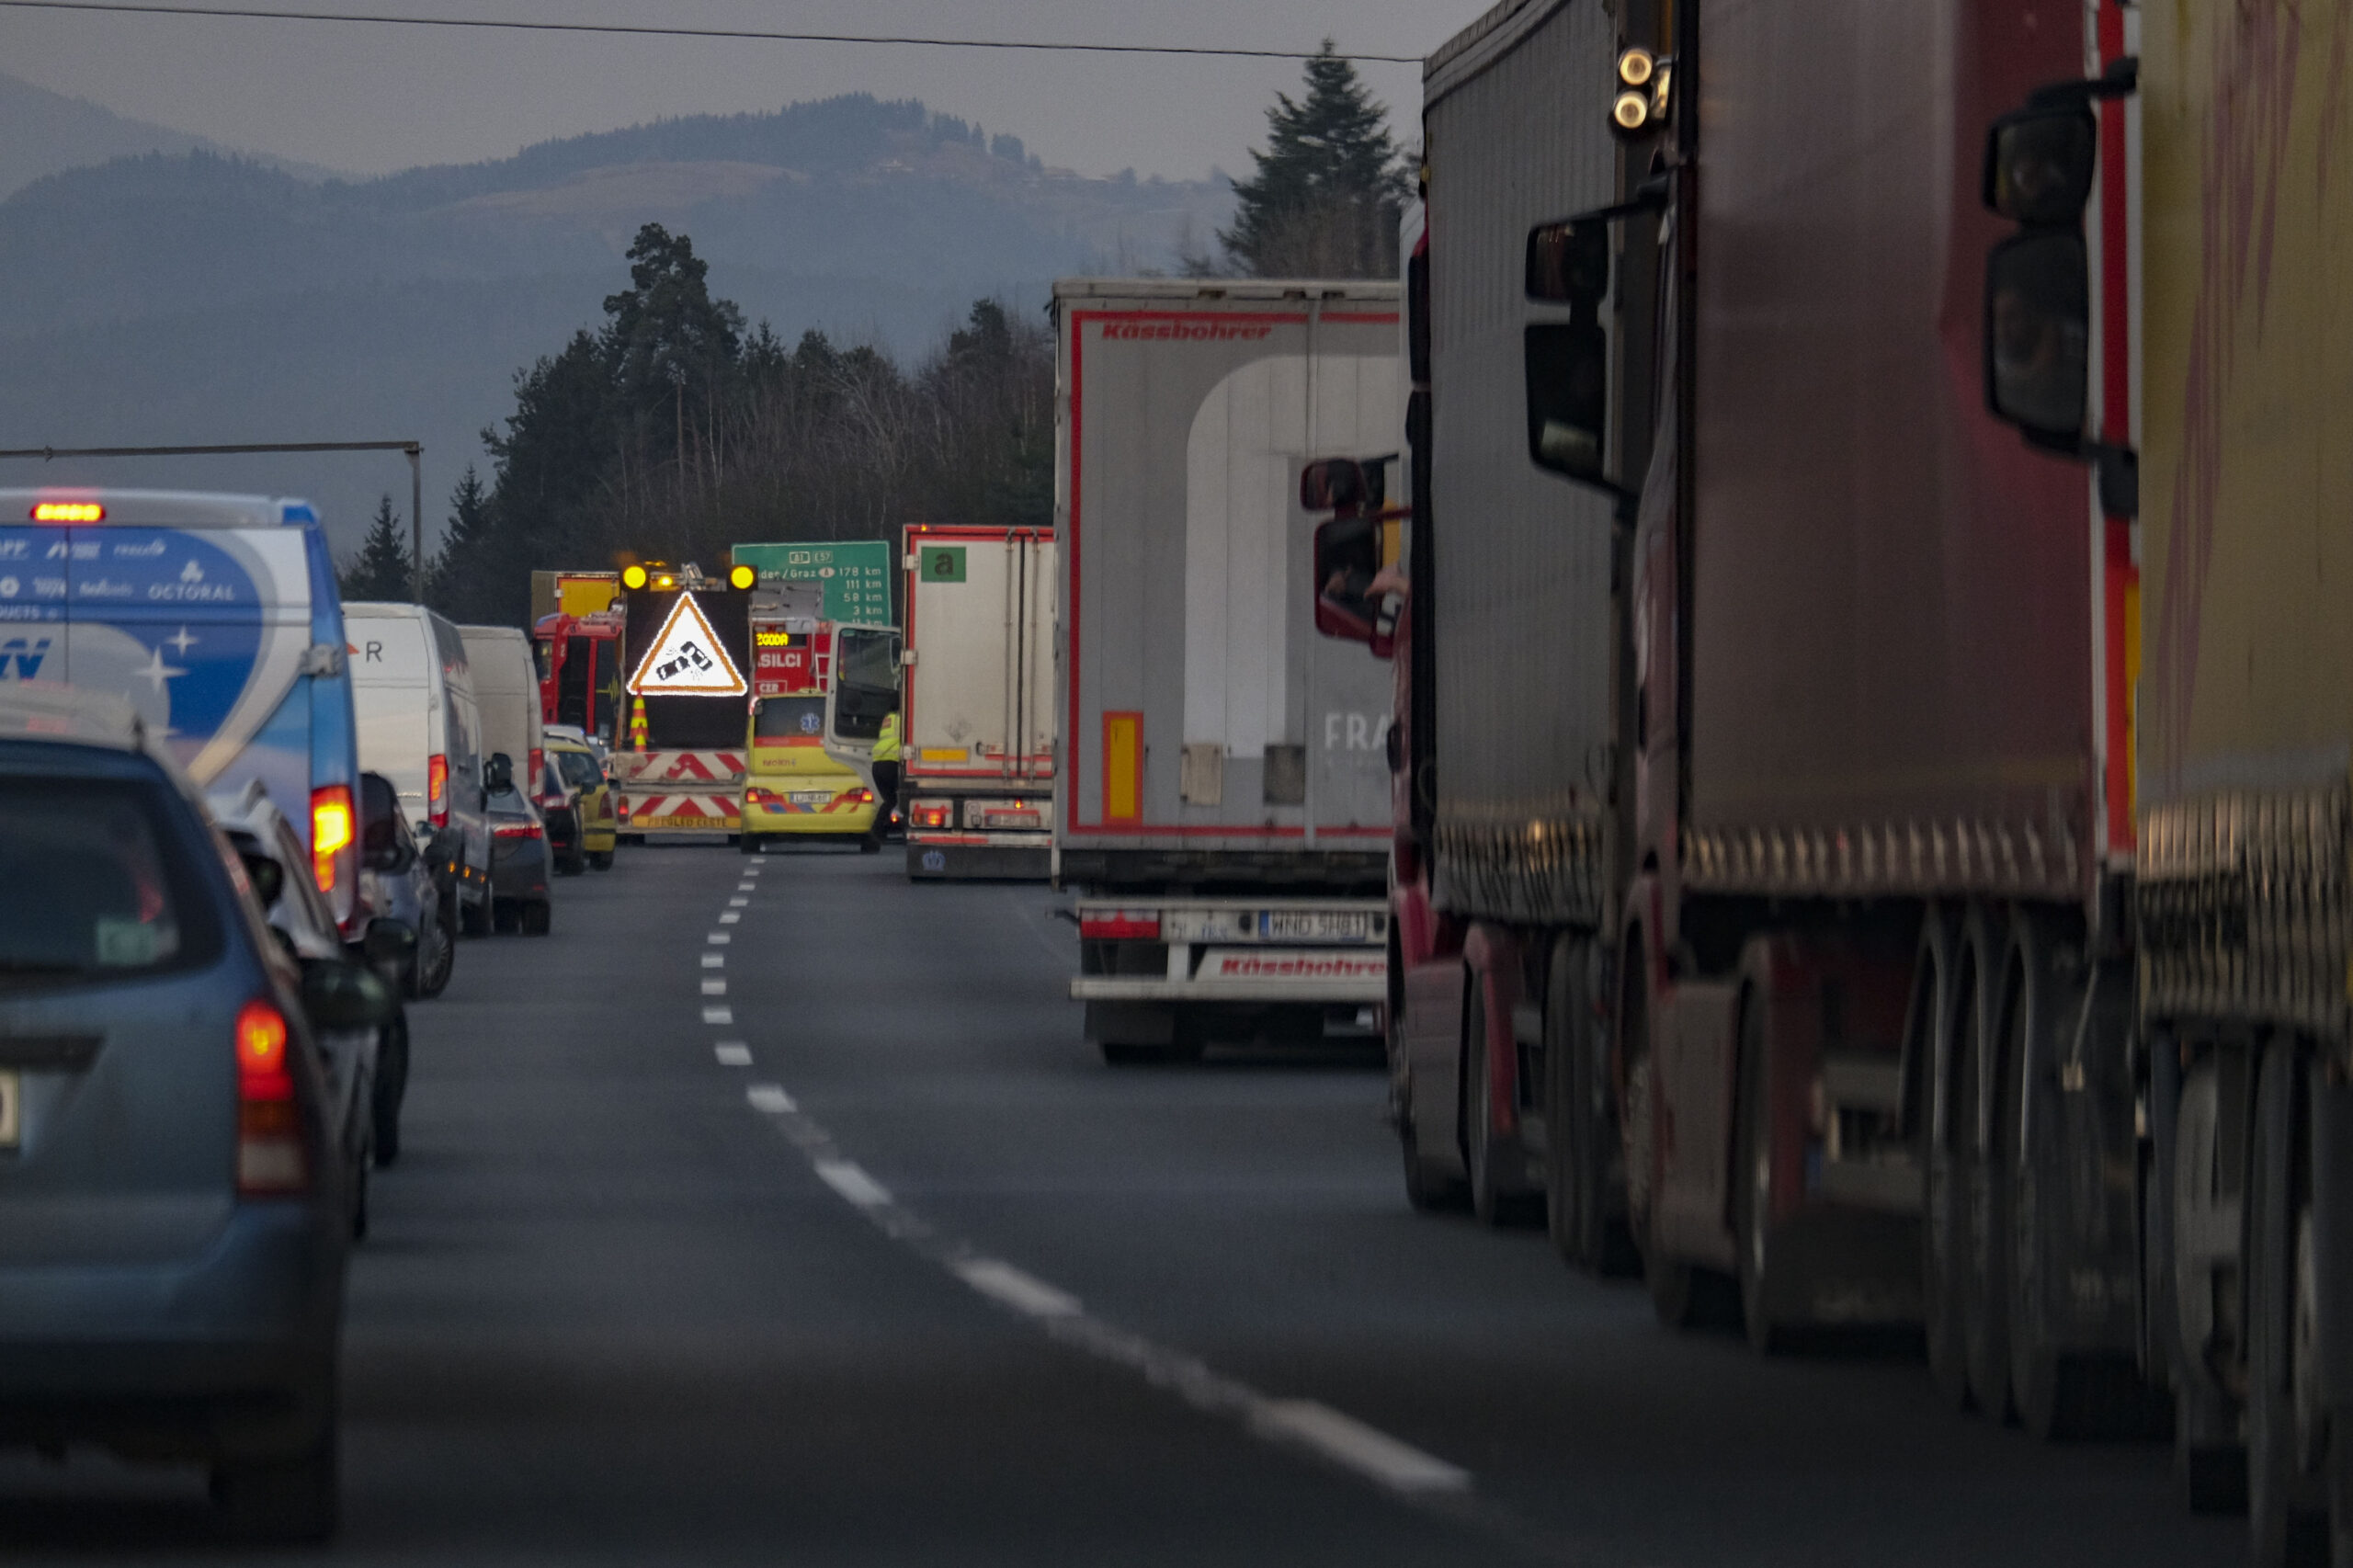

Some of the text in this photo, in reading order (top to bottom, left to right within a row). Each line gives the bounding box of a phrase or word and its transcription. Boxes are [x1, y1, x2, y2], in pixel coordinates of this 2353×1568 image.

[838, 567, 859, 577] 178
[865, 566, 881, 576] km
[846, 579, 882, 590] 111 km
[148, 583, 236, 601] OCTORAL
[844, 593, 882, 602] 58 km
[853, 605, 882, 615] 3 km
[366, 641, 383, 663] R
